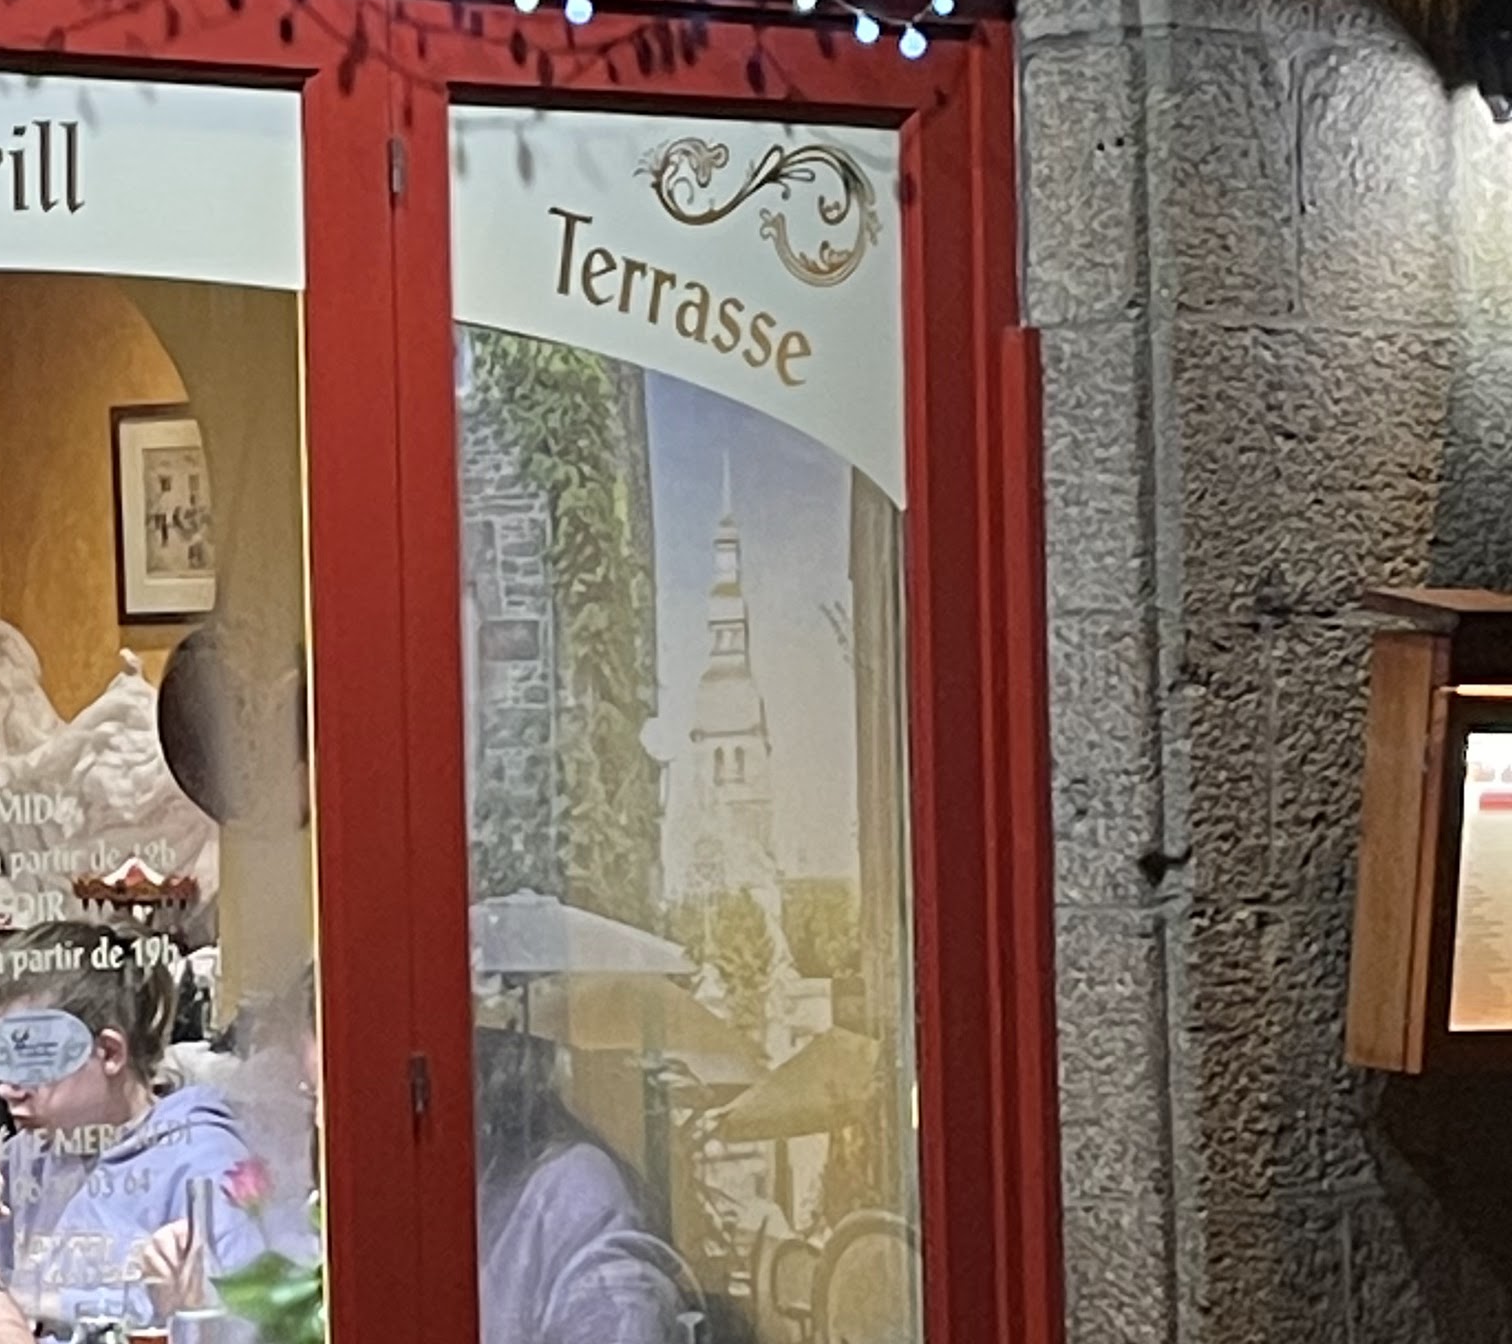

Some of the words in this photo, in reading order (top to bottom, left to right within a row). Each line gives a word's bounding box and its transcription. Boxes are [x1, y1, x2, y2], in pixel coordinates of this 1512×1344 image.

[548, 207, 813, 387] Terrasse
[10, 840, 81, 881] partir
[90, 837, 121, 874] de
[10, 940, 85, 981] partir
[90, 936, 124, 971] de
[130, 933, 178, 981] 19h
